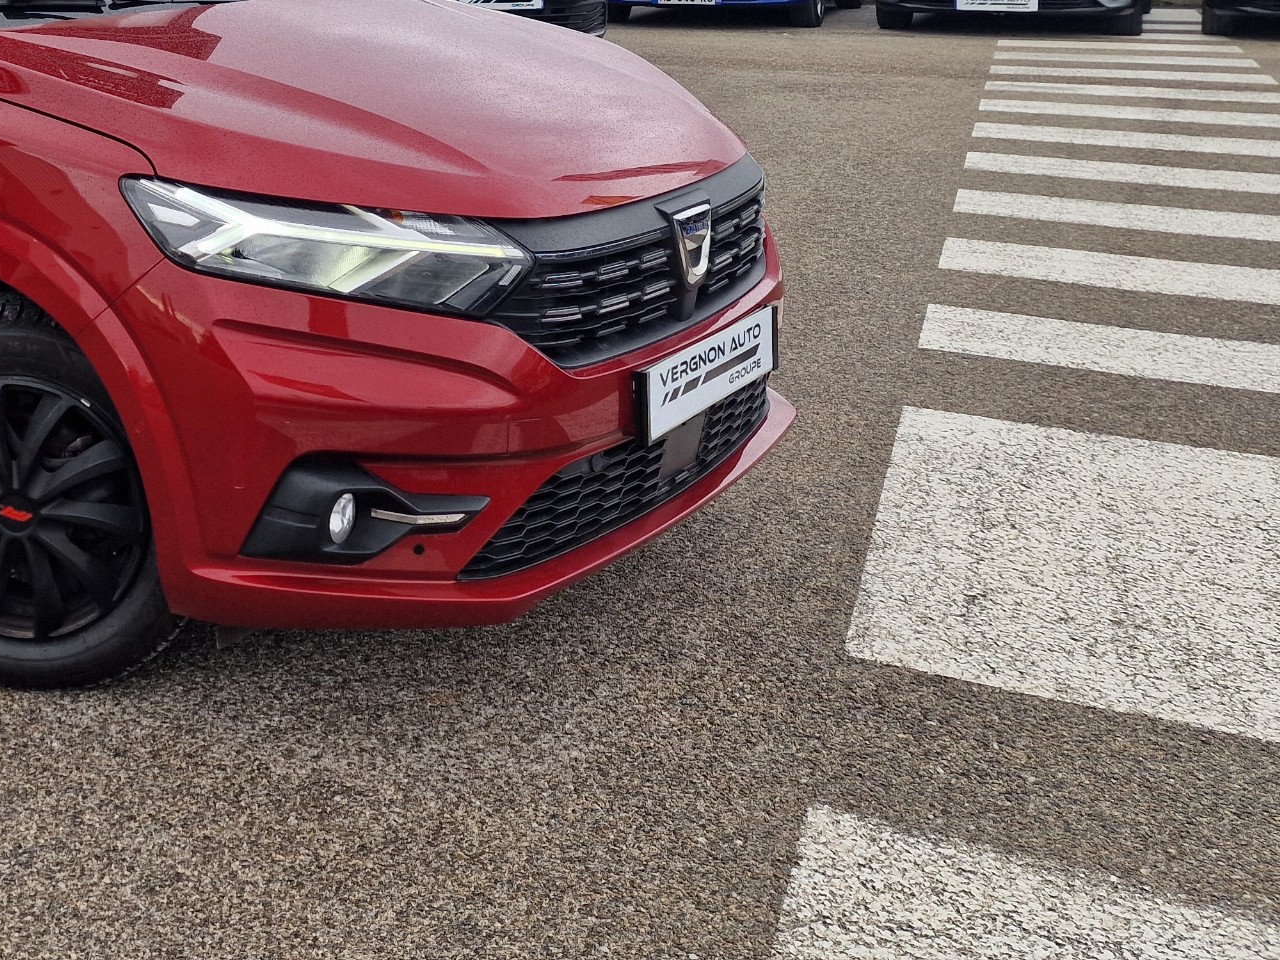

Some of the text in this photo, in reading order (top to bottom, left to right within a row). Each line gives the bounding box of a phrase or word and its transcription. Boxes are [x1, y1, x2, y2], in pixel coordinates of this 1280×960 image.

[659, 323, 761, 388] VERGNON AUTO
[728, 357, 762, 384] GROUPE
